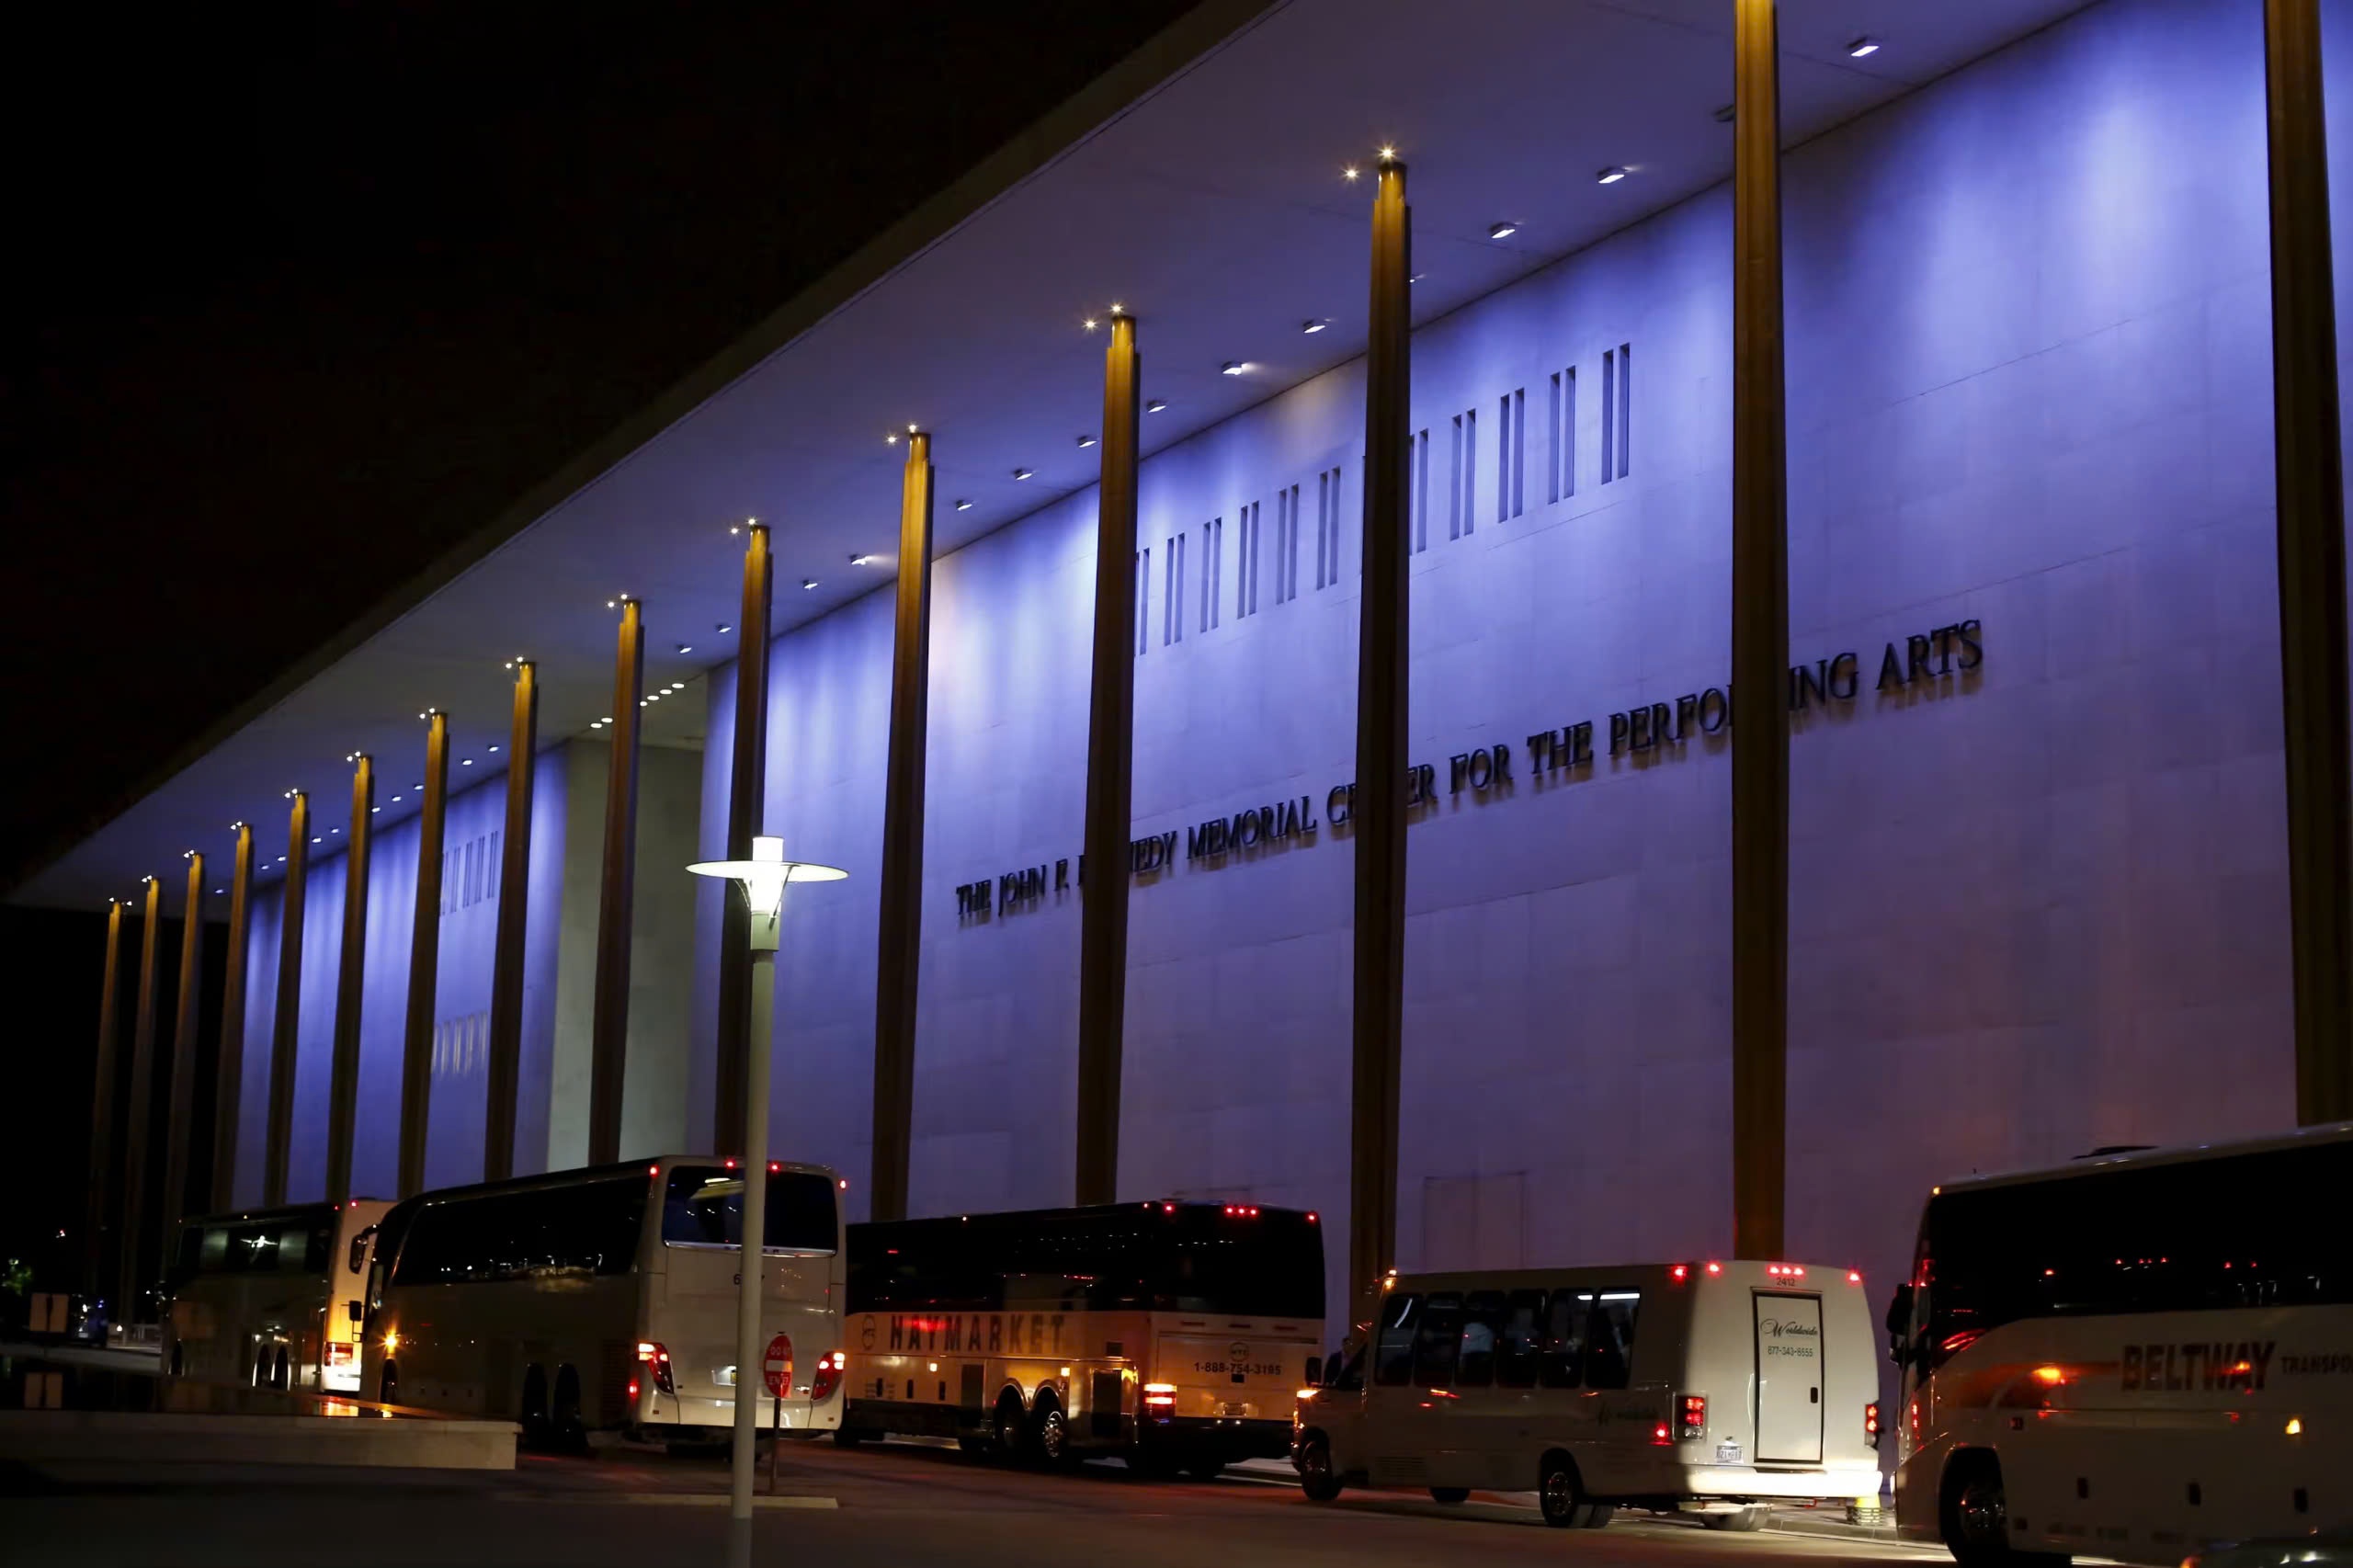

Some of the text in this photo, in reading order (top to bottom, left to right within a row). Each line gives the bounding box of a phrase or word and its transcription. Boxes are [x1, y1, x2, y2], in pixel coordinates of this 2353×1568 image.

[956, 879, 992, 915] THE
[998, 865, 1046, 917] JOHN
[1054, 858, 1070, 892] F.
[1187, 795, 1317, 860] MEMORIAL
[1326, 764, 1438, 824] CEER
[1449, 744, 1514, 794] FOR
[1527, 721, 1593, 774] THE
[1608, 653, 1859, 756] PERFOING
[1876, 619, 1983, 690] ARTS
[1776, 1277, 1796, 1287] 2412
[890, 1314, 1065, 1354] HAYMARKET
[2120, 1341, 2276, 1392] BELTWAY
